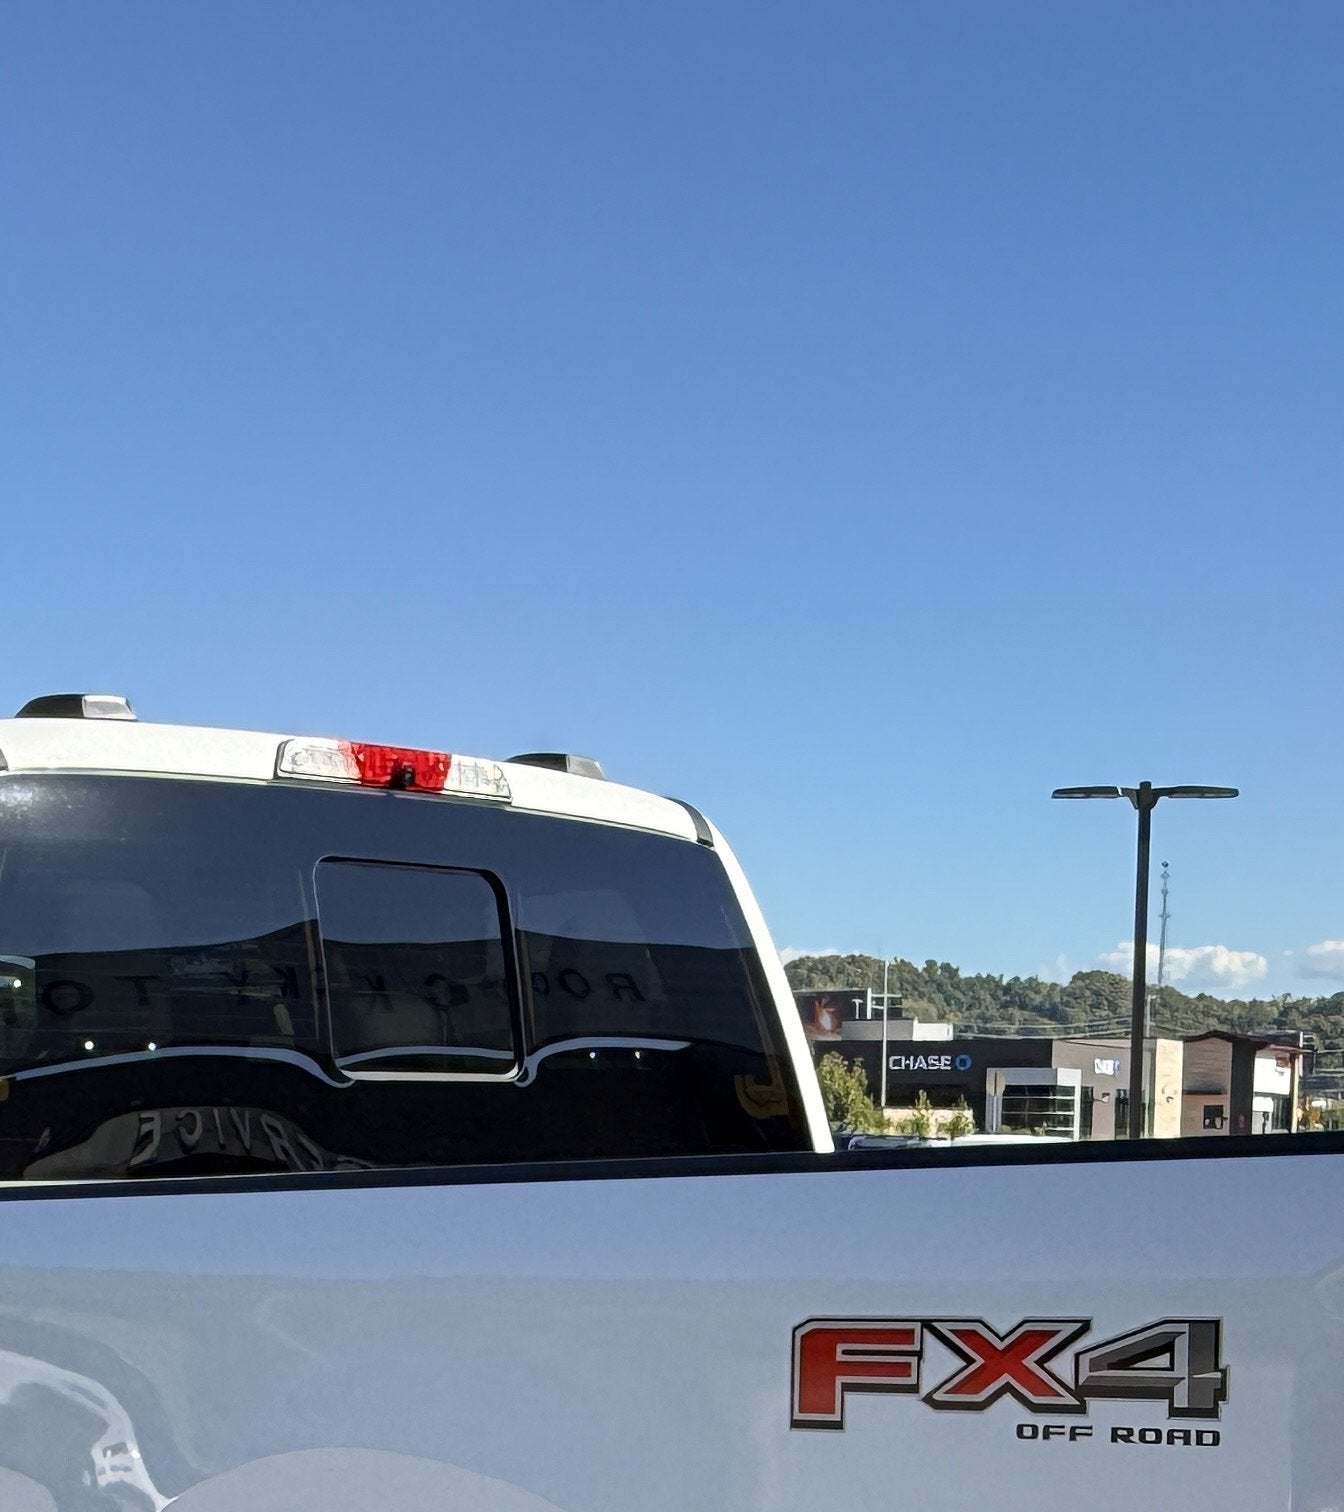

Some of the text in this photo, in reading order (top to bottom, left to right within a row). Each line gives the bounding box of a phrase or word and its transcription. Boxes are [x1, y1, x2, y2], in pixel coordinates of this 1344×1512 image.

[888, 1055, 952, 1071] CHASE
[790, 1315, 1230, 1431] FX4
[1015, 1423, 1221, 1447] OFF ROAD
